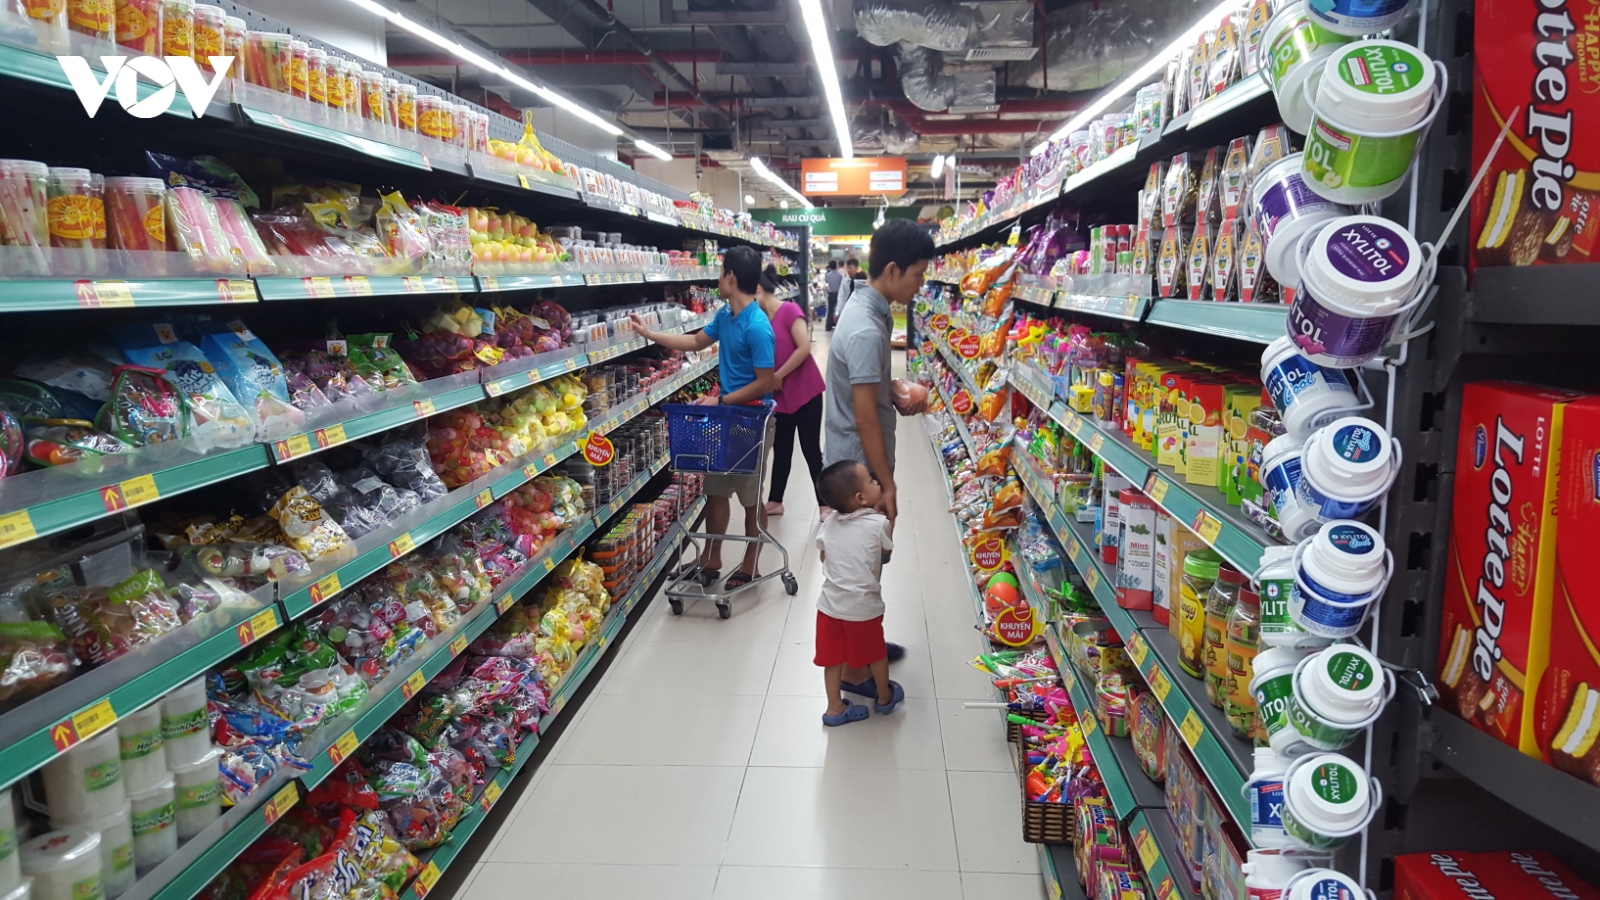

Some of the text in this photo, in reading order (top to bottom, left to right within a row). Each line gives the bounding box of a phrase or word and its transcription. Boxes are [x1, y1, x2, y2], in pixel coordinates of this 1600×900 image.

[1364, 47, 1395, 93] XYLITOL
[1361, 225, 1377, 239] LOTTE
[1342, 229, 1392, 275] XYLITOL
[1347, 427, 1361, 452] XYLITOL
[1532, 416, 1546, 478] LOTTE
[115, 580, 142, 599] TWO
[1001, 620, 1030, 630] KHUYẾN
[1339, 656, 1360, 685] XYLITOL
[1329, 766, 1341, 800] XYLITOL
